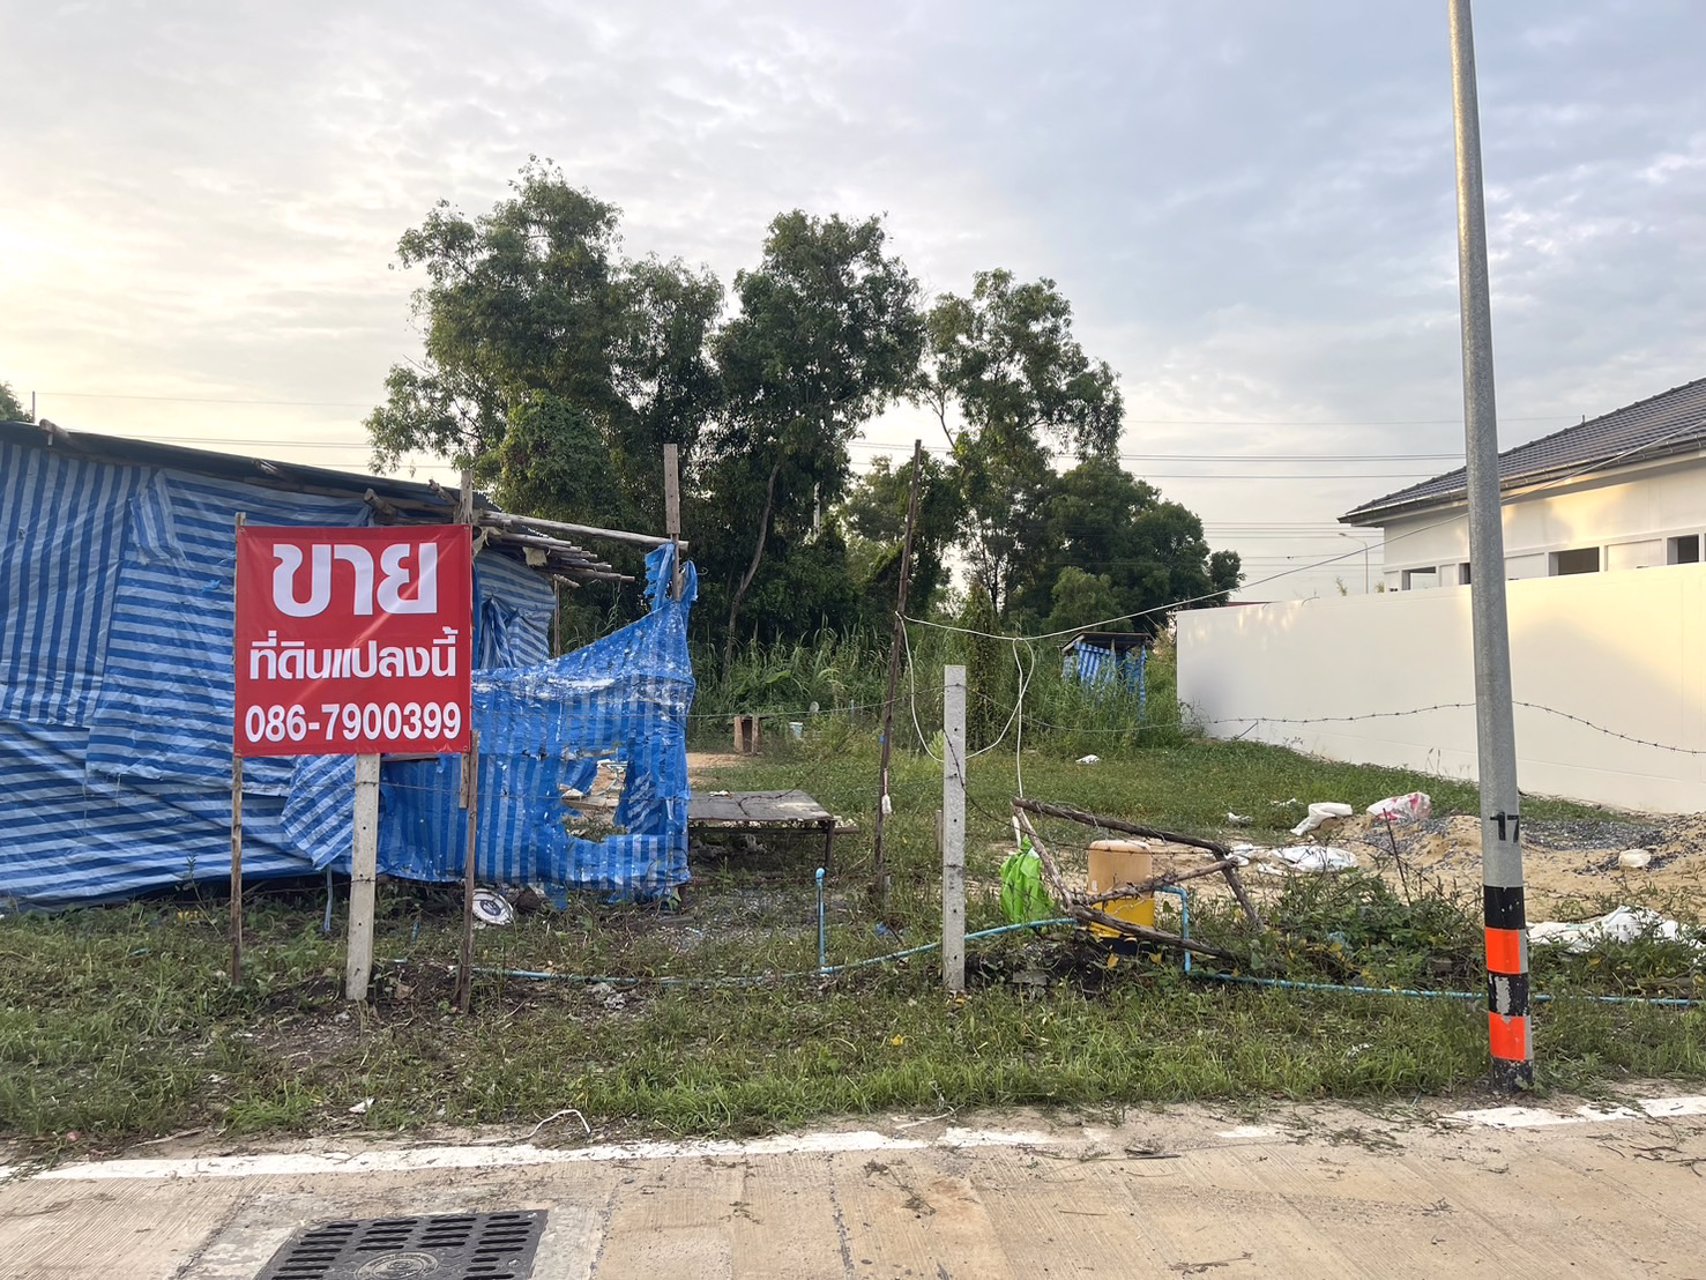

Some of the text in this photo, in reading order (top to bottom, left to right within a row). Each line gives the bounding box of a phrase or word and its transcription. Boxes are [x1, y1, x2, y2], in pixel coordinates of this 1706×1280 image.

[272, 542, 438, 618] ขาย
[249, 626, 459, 680] ที่ดินแปลงนี้
[244, 702, 462, 743] 086-7900399
[1489, 811, 1520, 843] 17
